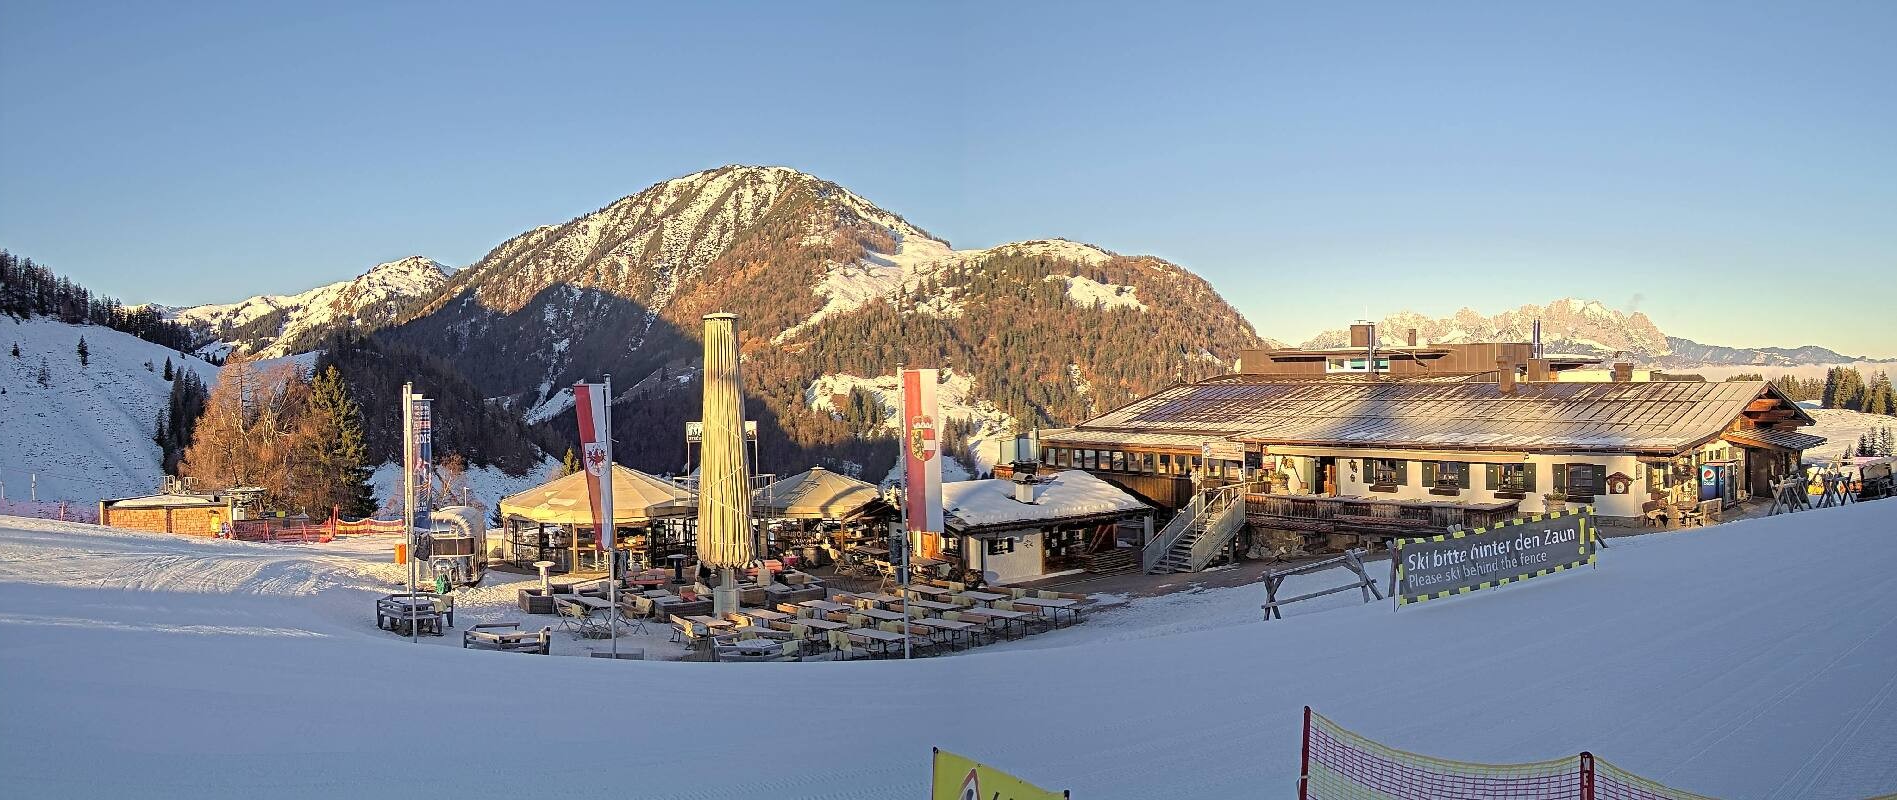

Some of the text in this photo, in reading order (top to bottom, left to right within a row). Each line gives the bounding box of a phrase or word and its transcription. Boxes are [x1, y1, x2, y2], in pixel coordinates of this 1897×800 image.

[415, 434, 431, 443] 2015
[1408, 552, 1429, 571] Ski
[1433, 549, 1467, 568] bitte
[1471, 542, 1511, 560] hinter
[1514, 534, 1540, 551] den
[1544, 527, 1575, 546] Zaun
[1409, 550, 1547, 588] Please ski behind the fence
